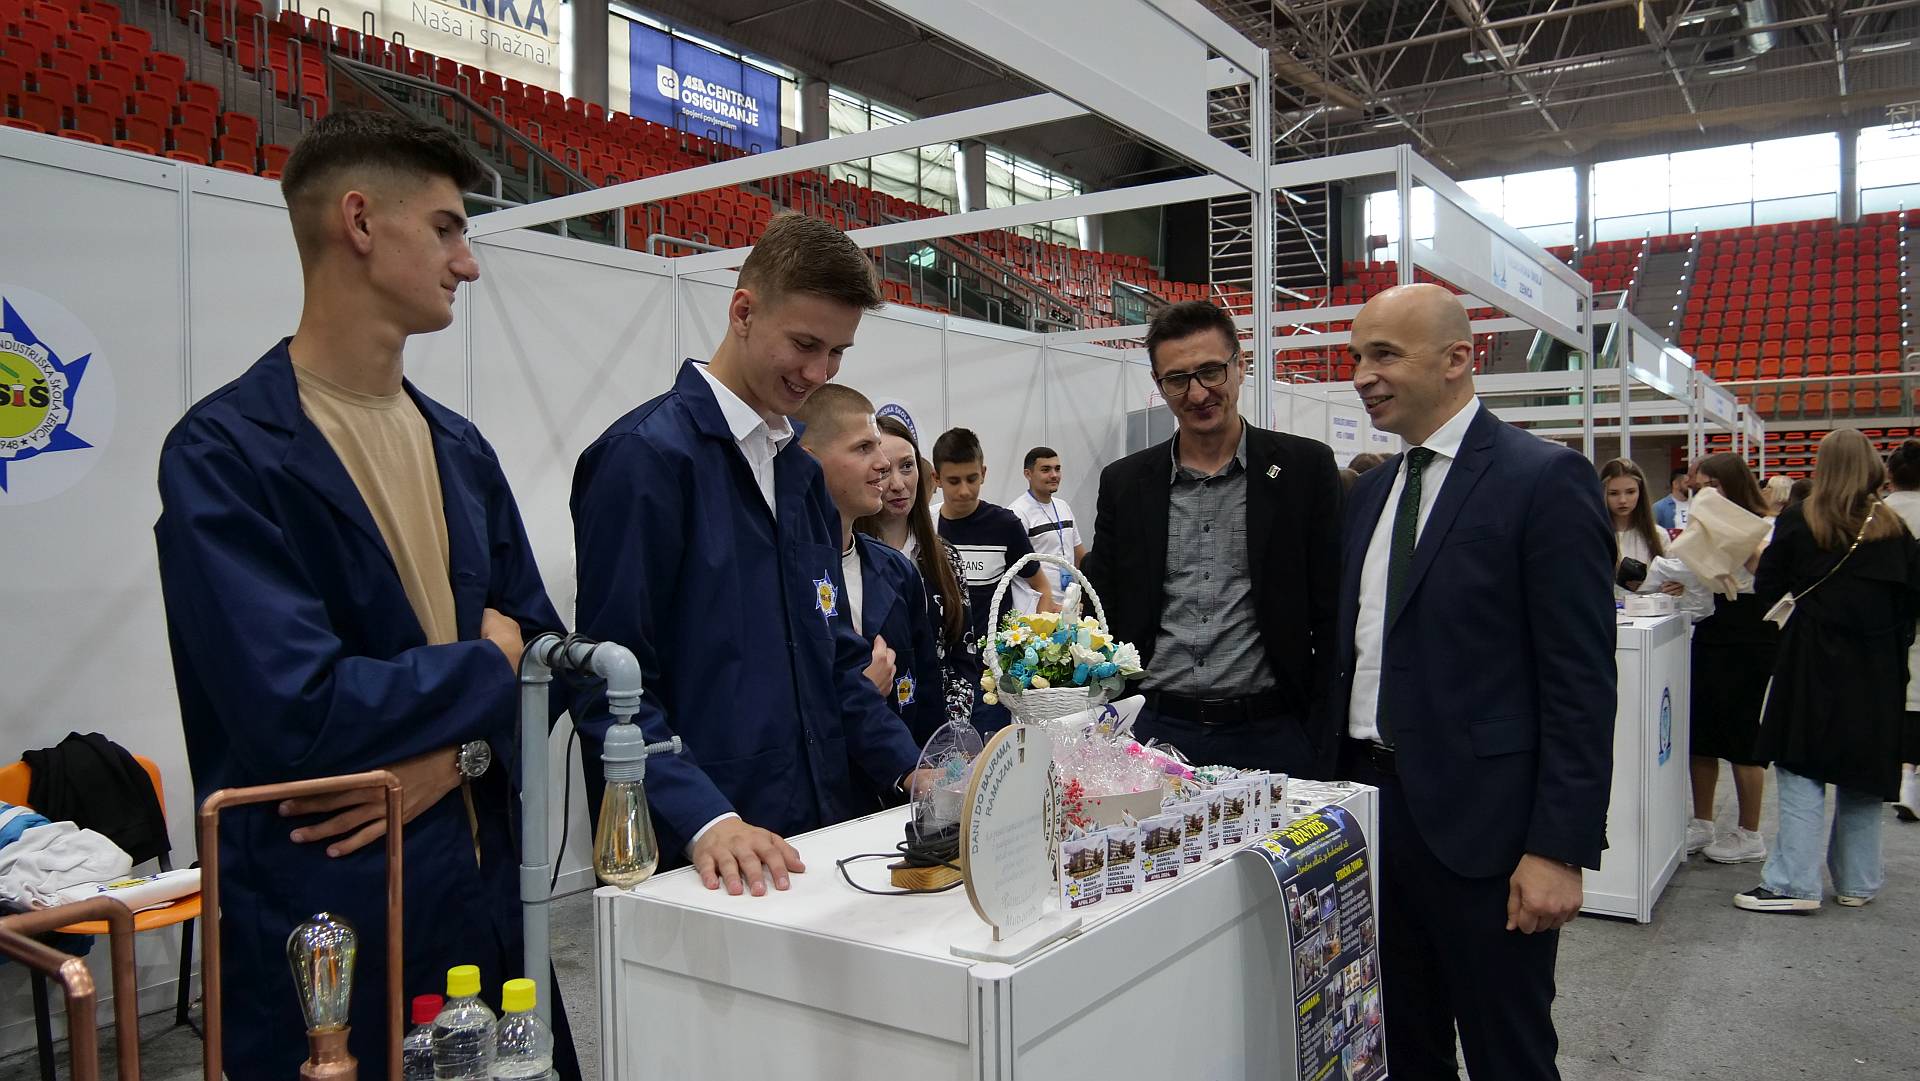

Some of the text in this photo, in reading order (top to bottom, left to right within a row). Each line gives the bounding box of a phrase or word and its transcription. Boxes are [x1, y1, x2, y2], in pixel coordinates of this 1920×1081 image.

[412, 1, 551, 66] Naša i snažna!
[681, 89, 759, 127] OSIGURANJE
[682, 74, 759, 113] ASA CENTRAL
[49, 379, 63, 412] ŠKOLA
[28, 412, 60, 442] ZENICA
[971, 740, 1011, 855] DANI DO BAJRAMA
[985, 756, 1013, 817] RAMAZAN
[1286, 820, 1329, 846] 2024/2025
